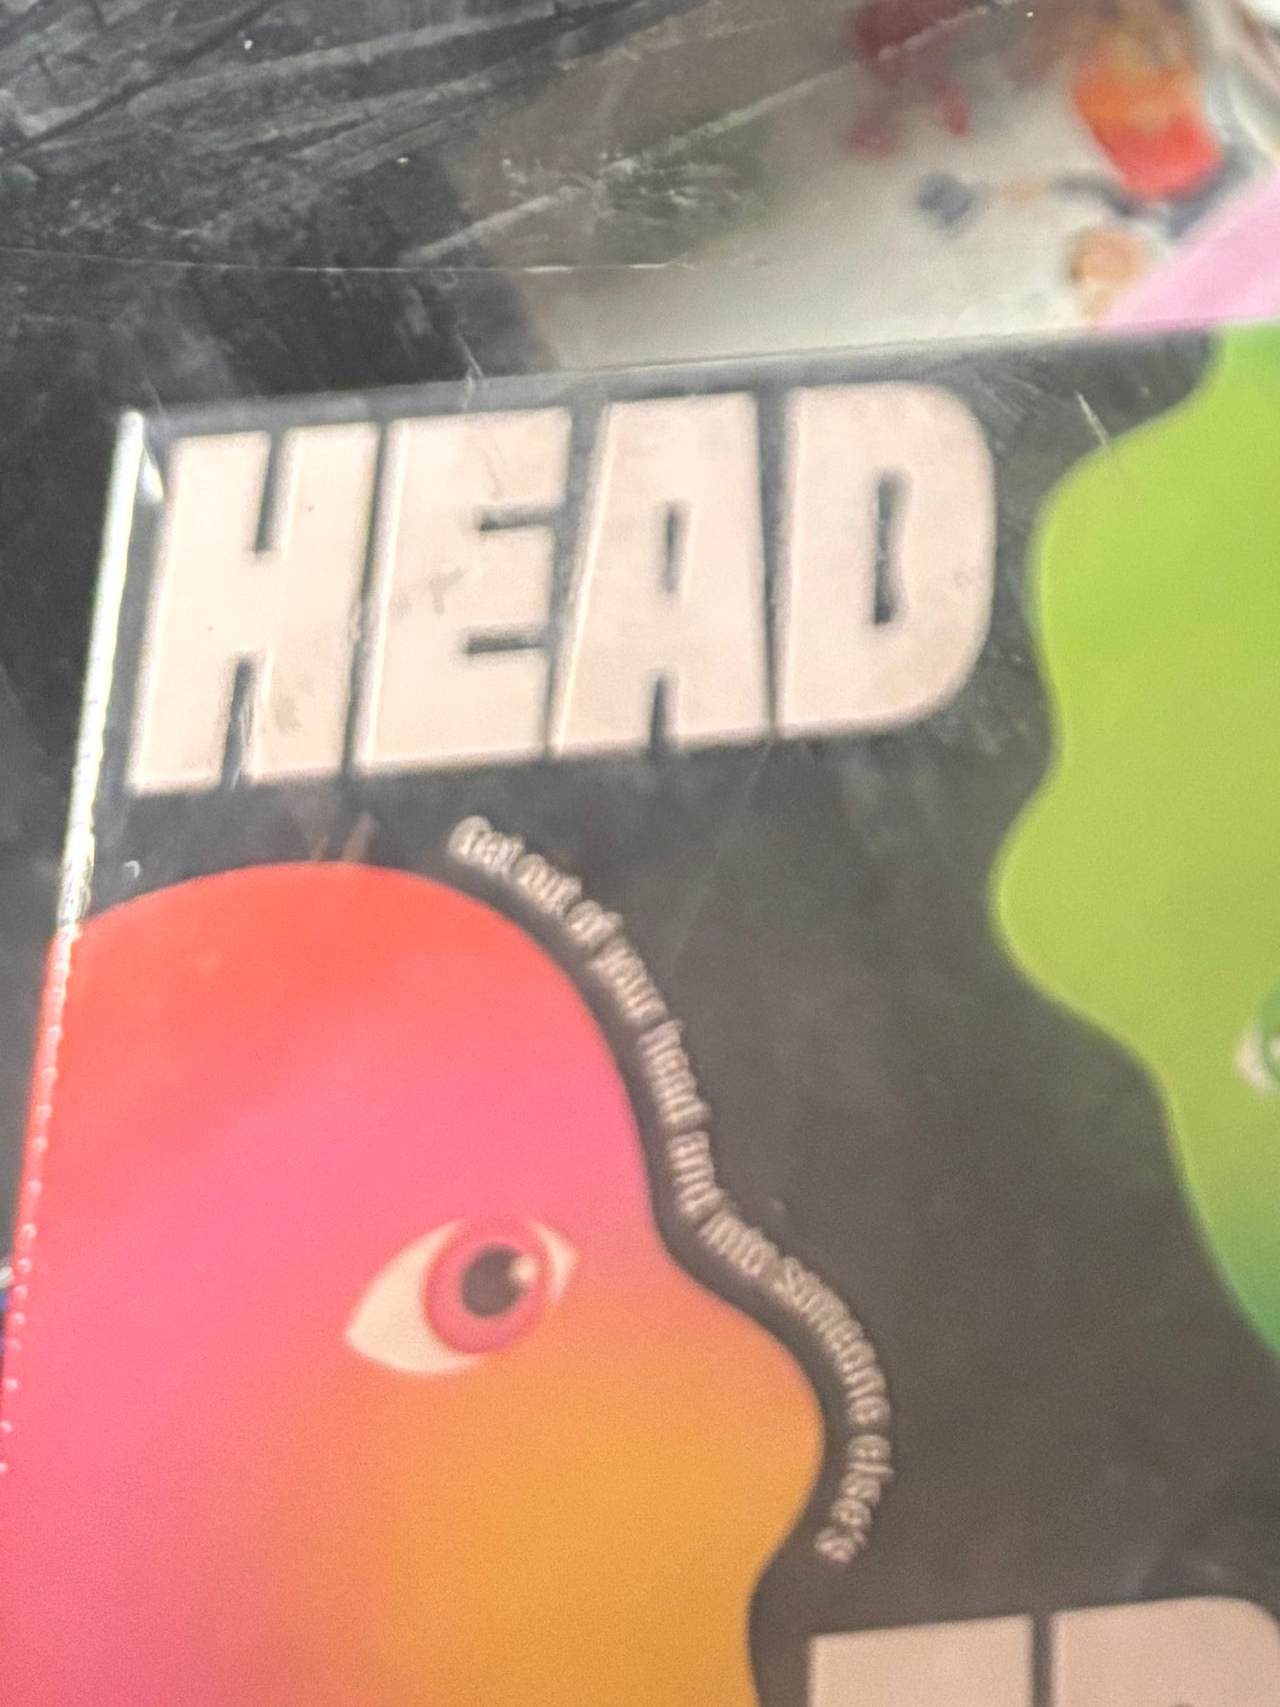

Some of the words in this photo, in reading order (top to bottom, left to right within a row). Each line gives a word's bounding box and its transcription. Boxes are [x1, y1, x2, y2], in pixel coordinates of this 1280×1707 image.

[127, 382, 997, 794] HEAD
[449, 815, 524, 876] Get
[511, 854, 583, 918] out
[565, 899, 623, 949] of
[587, 937, 668, 1029] your
[636, 1017, 711, 1132] head
[666, 1131, 724, 1224] and
[698, 1209, 780, 1278] into
[773, 1255, 891, 1425] someone
